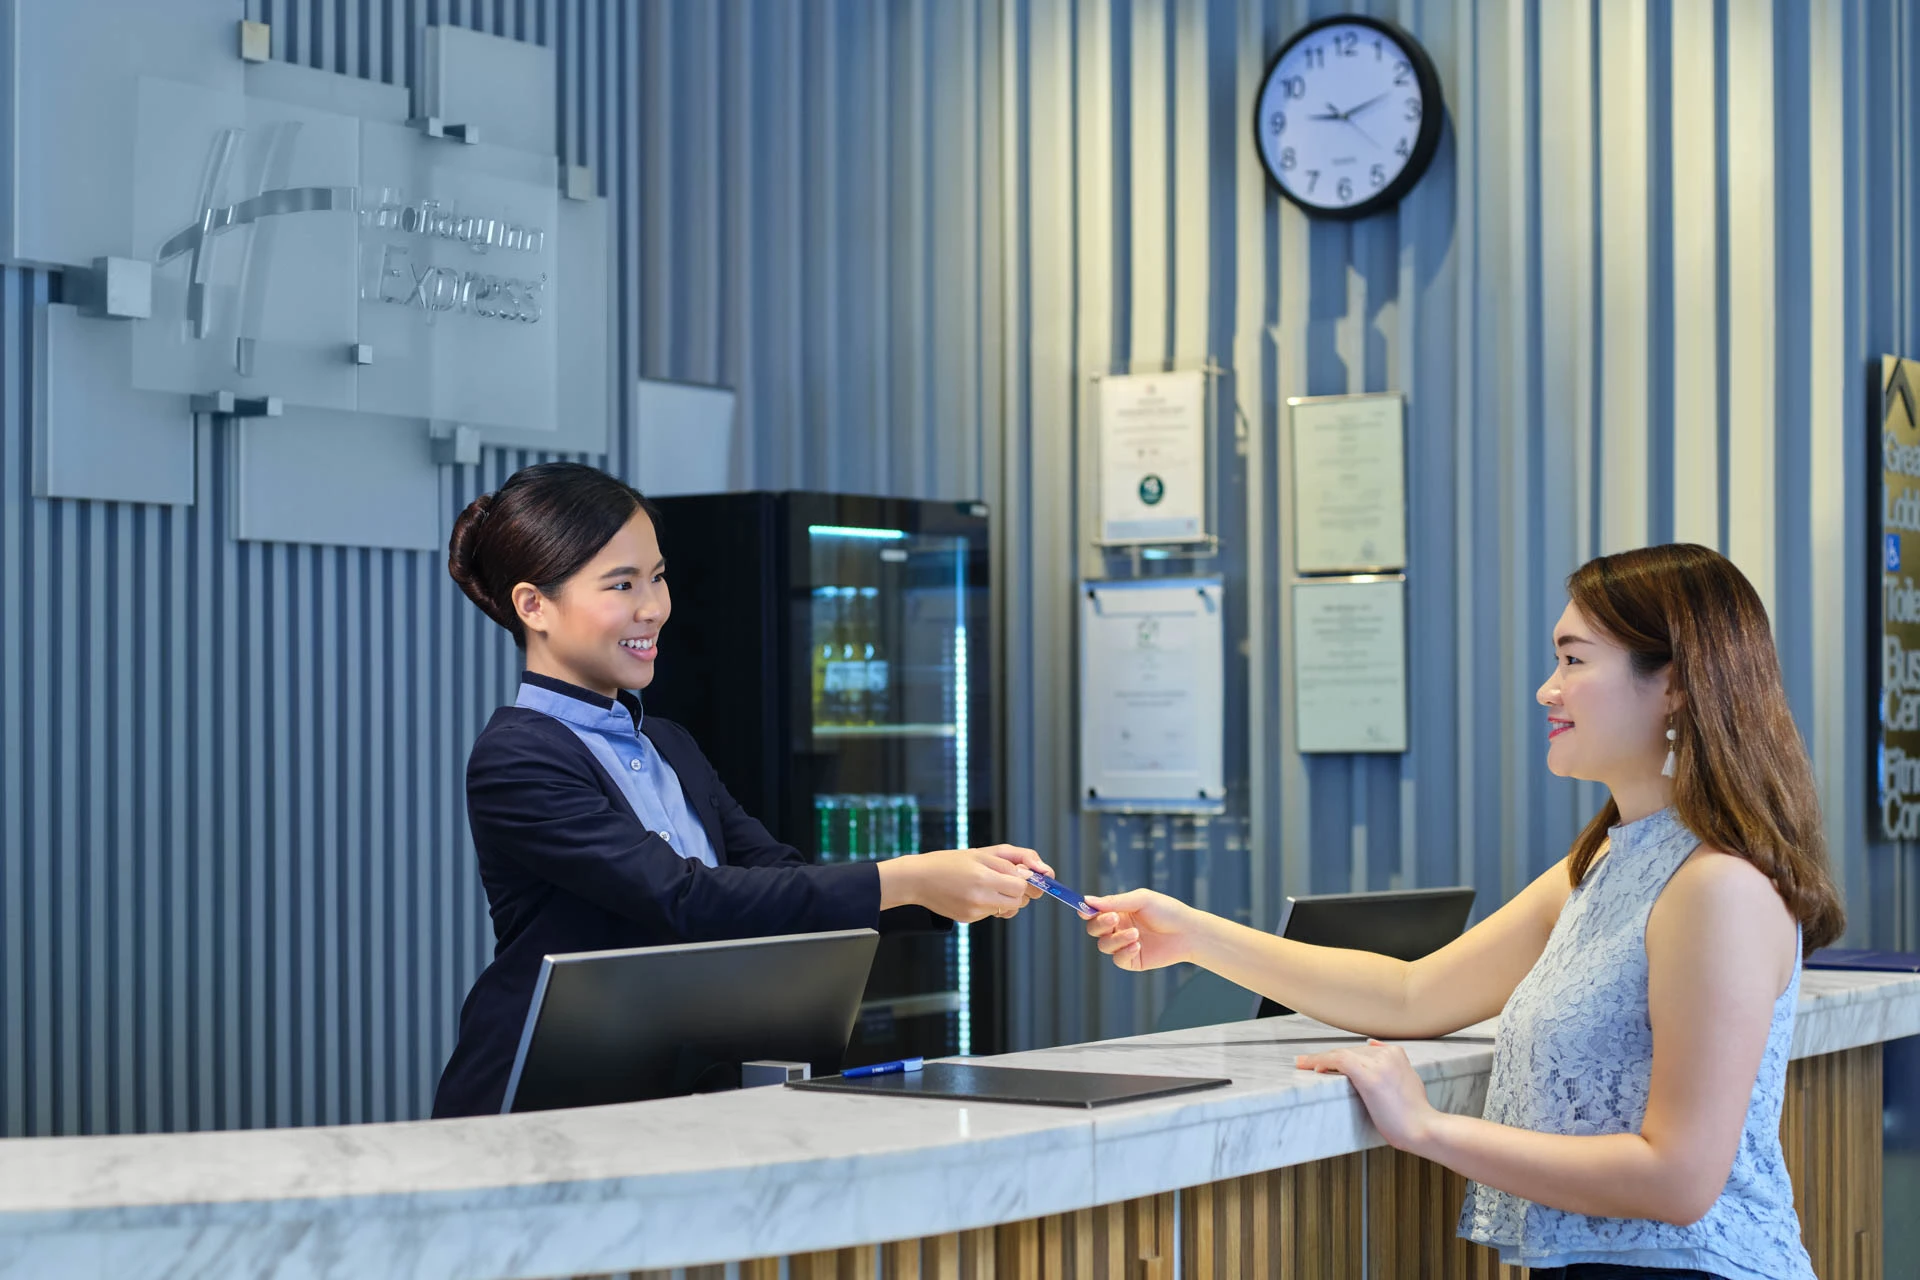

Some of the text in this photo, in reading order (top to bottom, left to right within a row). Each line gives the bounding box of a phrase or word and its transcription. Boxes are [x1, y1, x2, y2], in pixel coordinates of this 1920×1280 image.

[1333, 32, 1358, 56] 12
[1373, 39, 1382, 61] 1
[1305, 46, 1324, 68] 11
[1393, 61, 1411, 86] 2
[1281, 75, 1305, 100] 10
[1405, 98, 1420, 121] 3
[1271, 112, 1286, 136] 9
[1281, 148, 1296, 170] 8
[1396, 138, 1409, 159] 4
[1306, 169, 1320, 193] 7
[1370, 164, 1385, 187] 5
[1337, 178, 1352, 200] 6
[378, 243, 543, 326] Express
